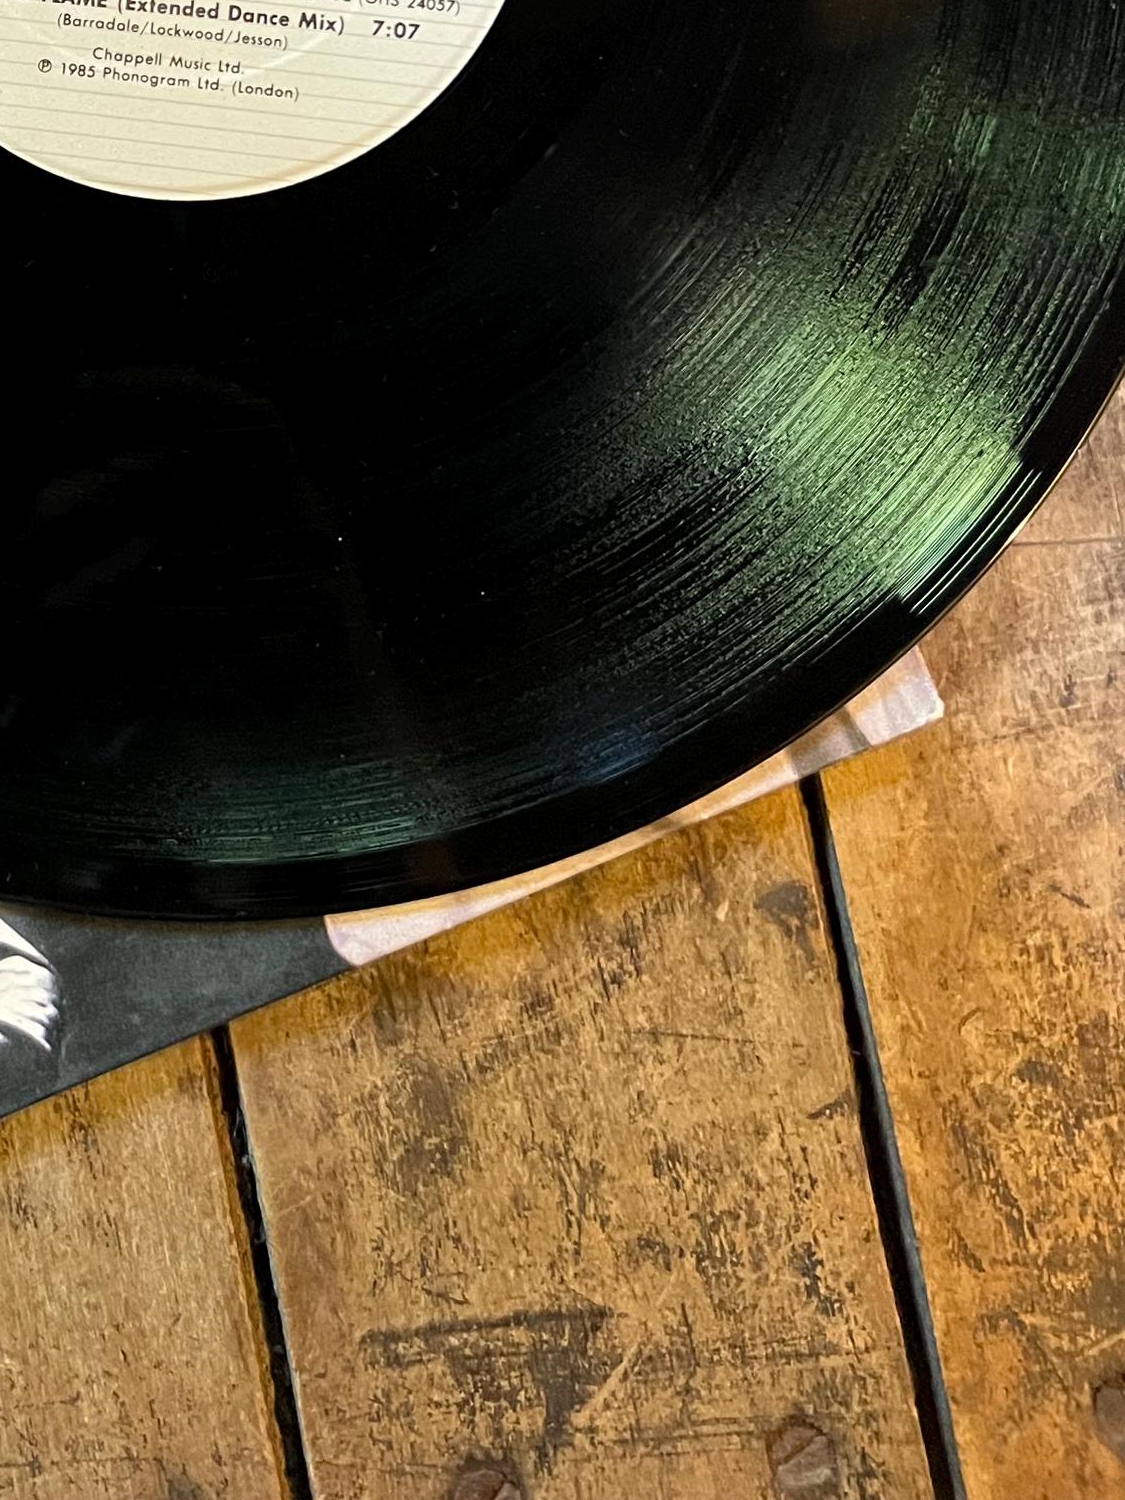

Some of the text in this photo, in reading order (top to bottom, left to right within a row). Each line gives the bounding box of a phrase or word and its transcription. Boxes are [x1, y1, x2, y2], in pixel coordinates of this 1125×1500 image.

[56, 12, 290, 51] (Barradale/Lockwood/Jesson)
[228, 3, 290, 28] Dance
[298, 11, 345, 36] Mix)
[371, 19, 421, 41] 7:07
[92, 46, 245, 76] Chappell Music Ltd.
[61, 61, 96, 79] 1985
[102, 66, 191, 89] Phonogram
[197, 75, 225, 92] Ltd.
[231, 79, 300, 102] (London)
